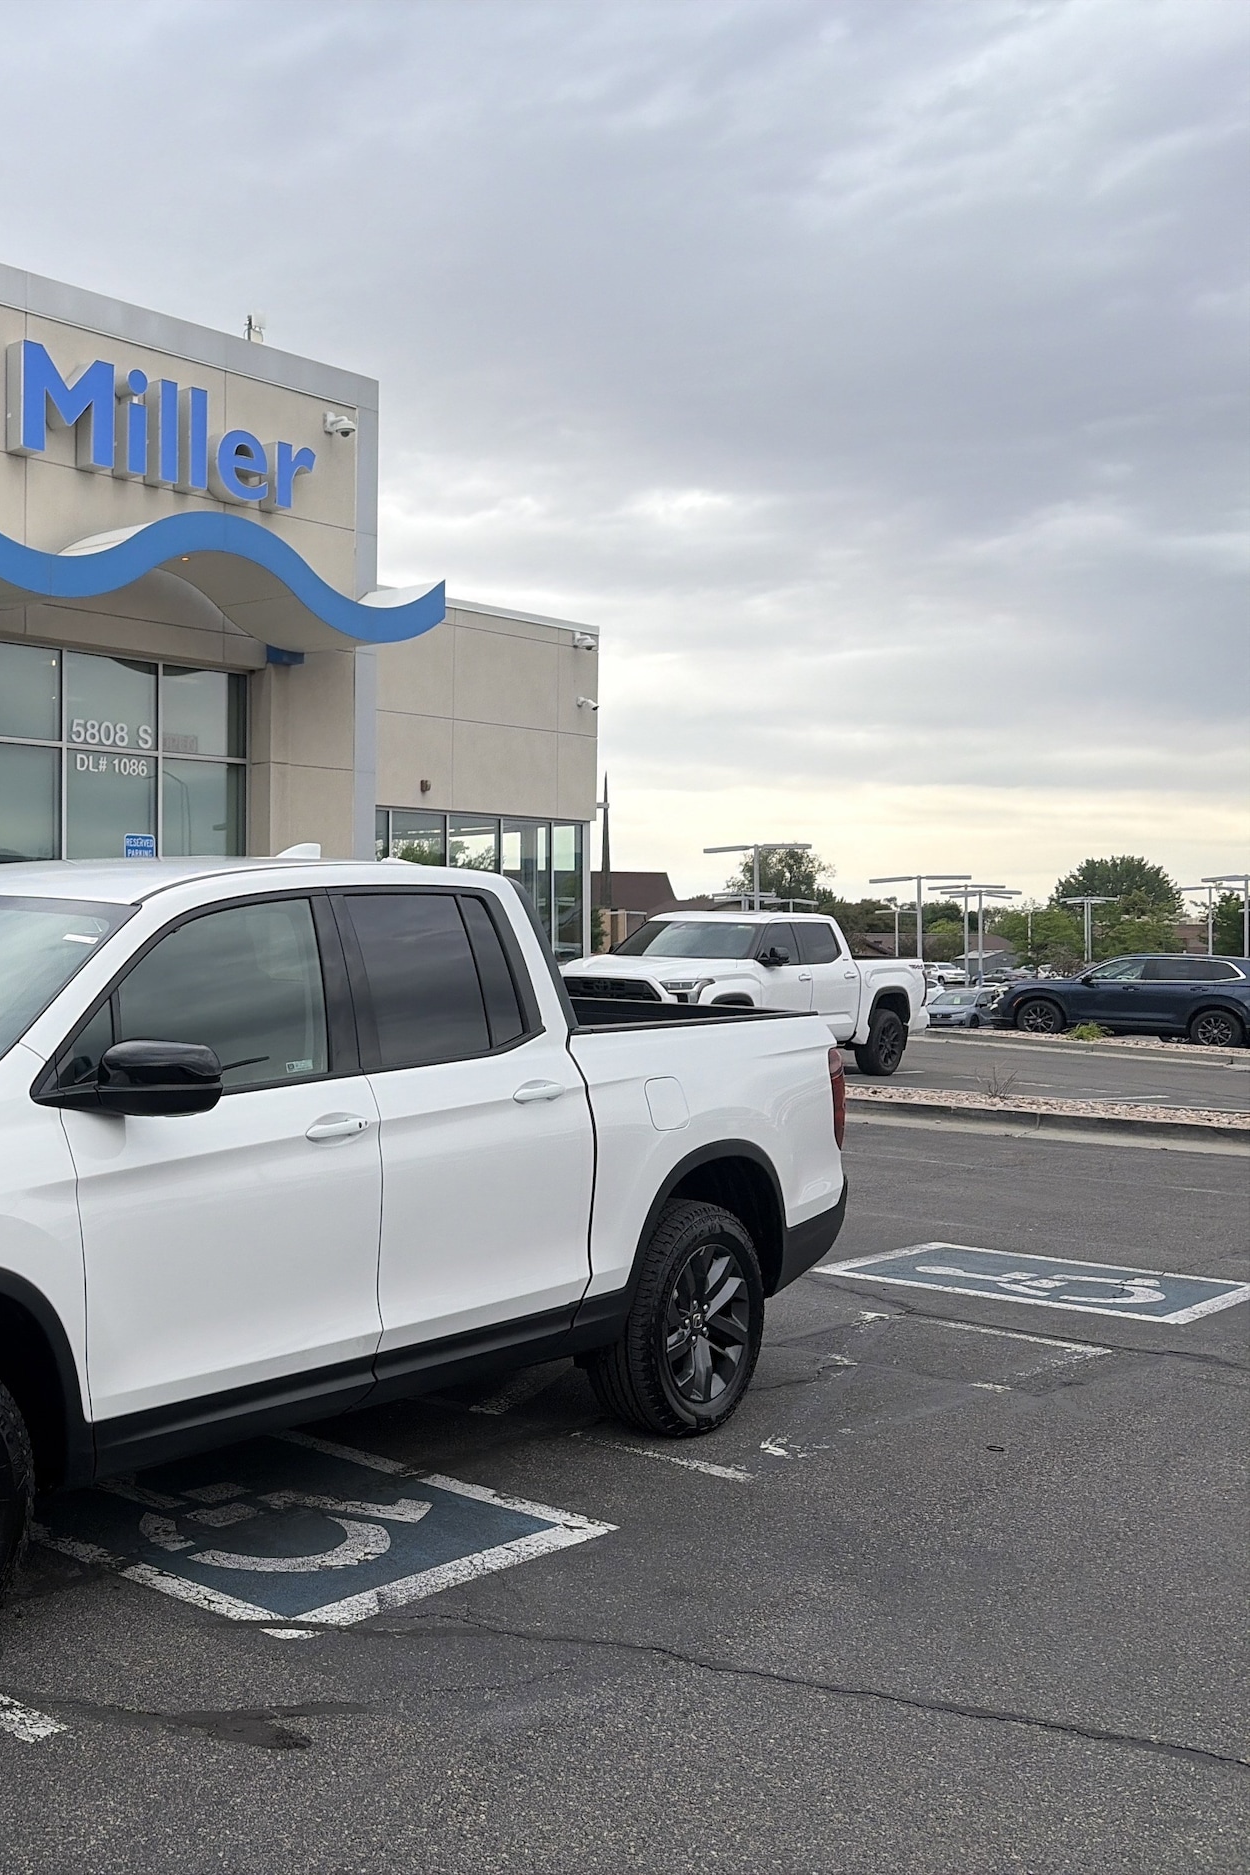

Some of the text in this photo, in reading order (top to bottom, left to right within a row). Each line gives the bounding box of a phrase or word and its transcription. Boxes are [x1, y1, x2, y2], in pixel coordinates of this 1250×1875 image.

[7, 339, 315, 509] Miller
[71, 719, 153, 749] 5808 S
[76, 754, 148, 776] DL# 1086
[126, 837, 154, 848] RESERVED
[127, 849, 153, 858] PARKING
